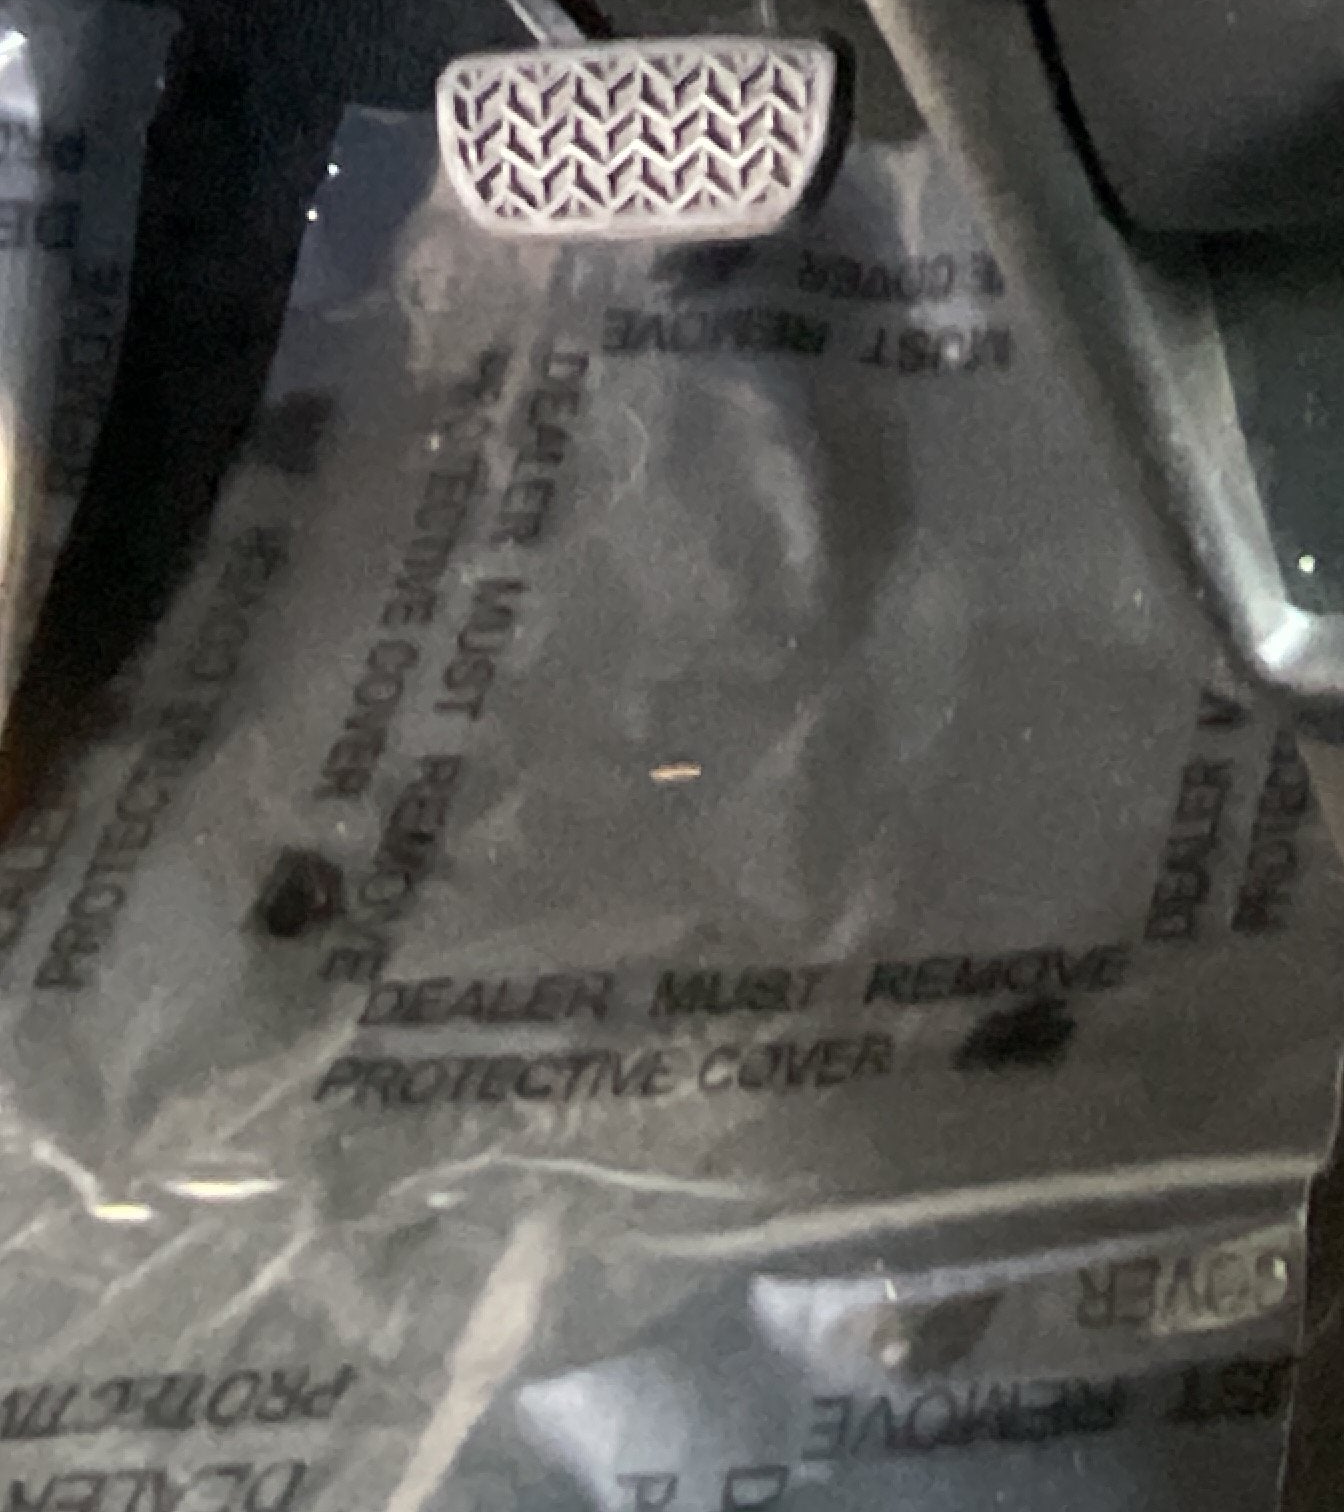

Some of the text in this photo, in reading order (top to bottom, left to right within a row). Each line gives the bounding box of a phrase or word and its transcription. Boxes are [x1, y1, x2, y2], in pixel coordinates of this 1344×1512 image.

[360, 942, 1134, 1027] DEALER MUST REMOVE
[312, 1031, 896, 1108] PROTECTIVE COVER
